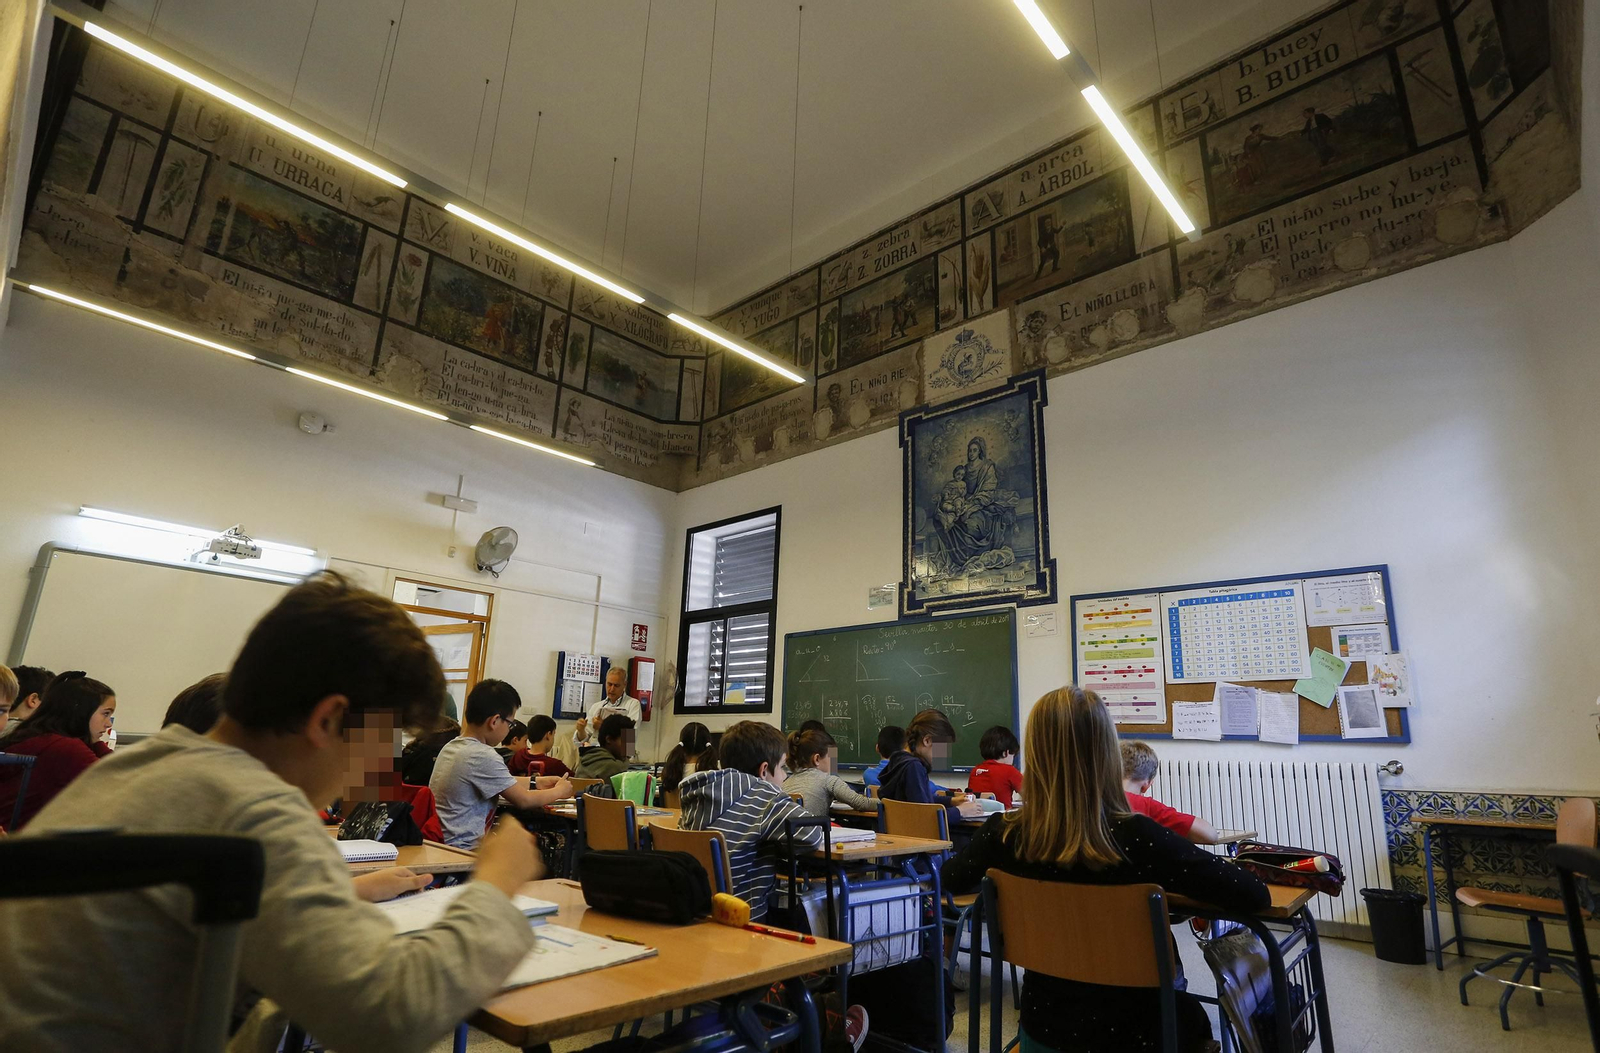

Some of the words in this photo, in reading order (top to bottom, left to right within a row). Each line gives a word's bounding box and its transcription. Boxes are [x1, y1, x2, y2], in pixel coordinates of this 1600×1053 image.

[1261, 27, 1324, 67] buey
[1264, 42, 1341, 92] BUHO
[291, 147, 337, 178] urna
[1037, 144, 1084, 175] arca
[273, 157, 344, 204] URRACA
[1038, 159, 1094, 198] ÁRBOL
[1257, 217, 1275, 239] El
[1283, 205, 1324, 229] ni-ño
[1332, 184, 1381, 210] su-be
[1388, 176, 1401, 197] y
[1408, 155, 1468, 183] ba-ja.
[877, 229, 910, 252] zebra
[1260, 233, 1280, 255] El
[1288, 215, 1351, 252] pe-rro
[1359, 203, 1383, 222] no
[488, 240, 519, 263] vaca
[874, 241, 918, 273] ZORRA
[222, 268, 239, 287] El
[484, 254, 517, 282] VIÑA
[747, 290, 783, 319] yunque
[1085, 292, 1113, 314] NIÑO
[624, 305, 665, 332] xabeque
[753, 306, 780, 329] YUGO
[441, 363, 455, 379] El
[443, 350, 458, 366] La
[460, 360, 489, 377] ca-bra
[497, 371, 506, 383] el
[868, 372, 888, 389] NIÑO
[440, 376, 452, 391] Yo
[943, 621, 954, 631] 30
[957, 619, 967, 629] de
[971, 617, 990, 628] abril
